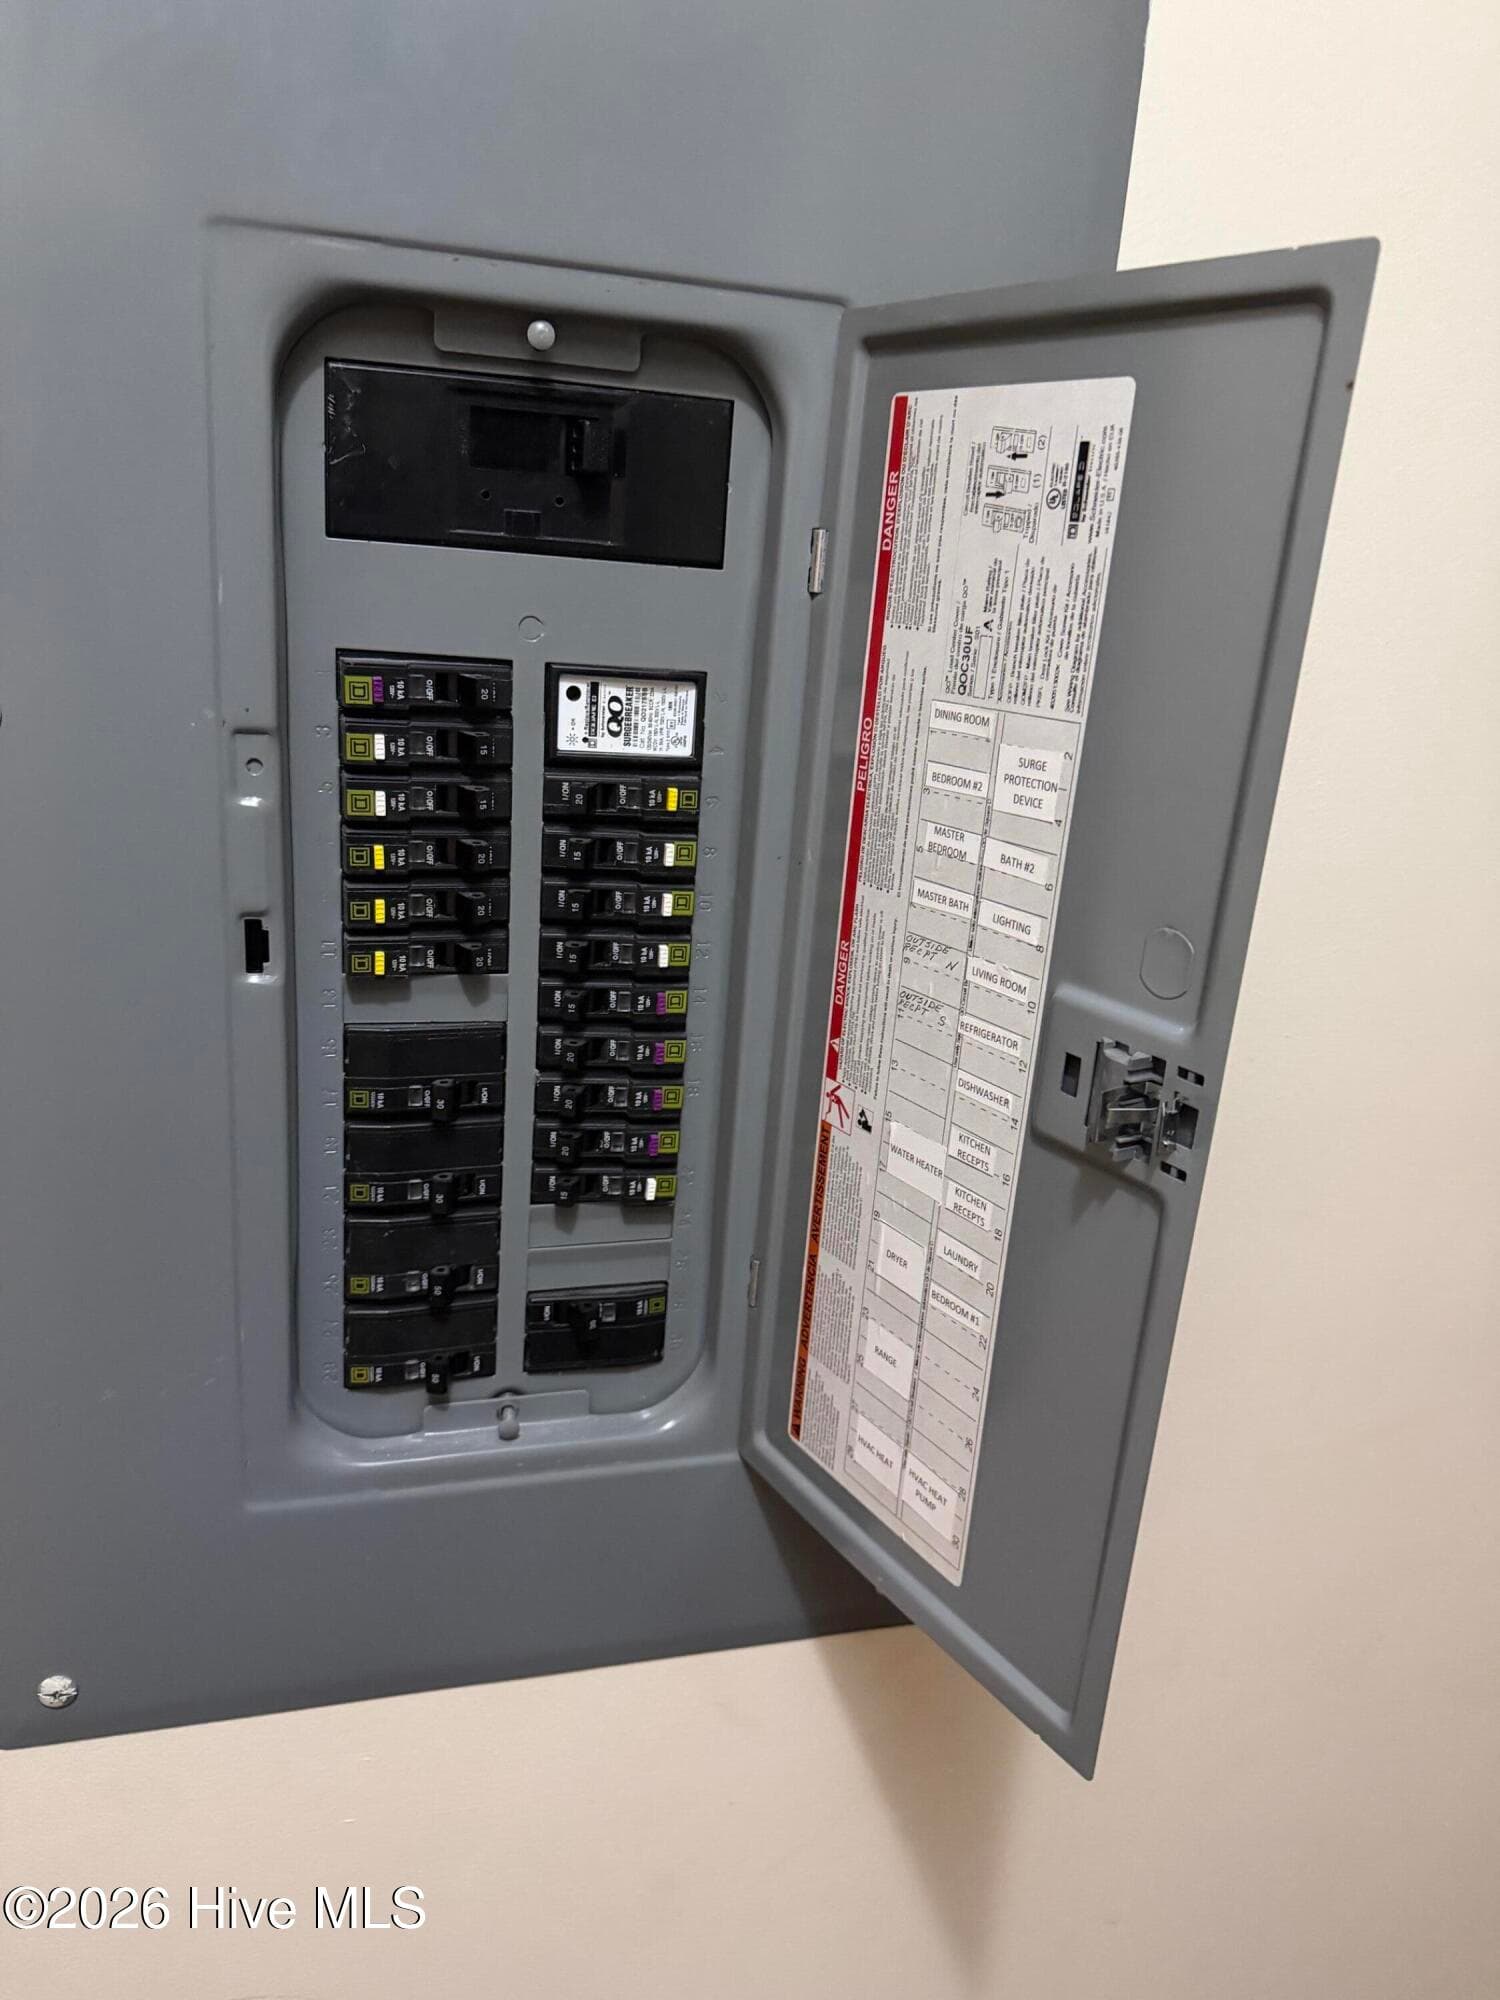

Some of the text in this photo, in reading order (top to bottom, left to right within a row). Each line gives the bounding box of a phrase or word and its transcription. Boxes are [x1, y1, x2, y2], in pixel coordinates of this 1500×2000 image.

[1038, 434, 1048, 450] (2)
[1032, 473, 1042, 488] (1)
[882, 471, 898, 551] DANGER
[984, 619, 994, 632] A
[958, 625, 974, 696] QOC30UF
[481, 688, 488, 700] 20
[606, 696, 624, 738] QO
[624, 686, 634, 747] SURGEBREAKER
[934, 708, 990, 728] DINING ROOM
[480, 745, 488, 755] 15
[857, 718, 872, 792] PELIGRO
[1064, 752, 1073, 760] 2
[1018, 757, 1048, 772] SURGE
[931, 771, 984, 792] BEDROOM #2
[1003, 773, 1058, 793] PROTECTION
[575, 794, 583, 805] 20
[924, 787, 930, 795] 3
[480, 800, 487, 810] 15
[1013, 794, 1044, 810] DEVICE
[1054, 819, 1062, 828] 4
[934, 826, 964, 843] MASTER
[478, 853, 486, 864] 20
[574, 852, 582, 861] 15
[927, 841, 967, 862] BEDROOM
[1000, 854, 1035, 874] BATH #2
[1044, 883, 1054, 892] 6
[572, 902, 580, 912] 15
[917, 887, 969, 912] MASTER BATH
[478, 906, 485, 916] 20
[992, 912, 1032, 936] LIGHTING
[905, 934, 950, 955] OUTSIDE
[1036, 944, 1044, 954] 8
[476, 956, 484, 968] 20
[569, 954, 577, 963] 15
[835, 940, 850, 1004] DANGER
[972, 966, 1027, 996] LIVING ROOM
[568, 1003, 576, 1014] 15
[899, 990, 944, 1012] OUTSIDE
[1027, 1000, 1037, 1015] 10
[959, 1021, 1019, 1050] REFRIGERATOR
[566, 1052, 575, 1063] 20
[890, 1059, 898, 1071] 13
[1018, 1058, 1028, 1073] 12
[957, 1076, 1010, 1109] DISHWASHER
[564, 1099, 574, 1110] 20
[1010, 1117, 1020, 1131] 14
[562, 1146, 569, 1156] 20
[958, 1132, 991, 1156] KITCHEN
[890, 1142, 944, 1179] WATER HEATER
[957, 1149, 990, 1172] RECEPTS
[810, 1126, 832, 1245] AVERTISSEMENT
[1002, 1172, 1010, 1187] 16
[954, 1186, 987, 1211] KITCHEN
[953, 1202, 985, 1227] RECEPTS
[994, 1228, 1002, 1242] 18
[886, 1248, 908, 1270] DRYER
[942, 1244, 979, 1274] LAUNDRY
[985, 1281, 994, 1298] 20
[801, 1253, 817, 1348] ADVERTENCIA
[931, 1289, 980, 1327] BEDROOM #1
[978, 1334, 987, 1350] 22
[874, 1345, 898, 1368] RANGE
[972, 1386, 980, 1402] 24
[858, 1434, 894, 1468] HVAC HEAT
[909, 1468, 948, 1506] HVAC HEAT
[915, 1489, 936, 1512] PUMP
